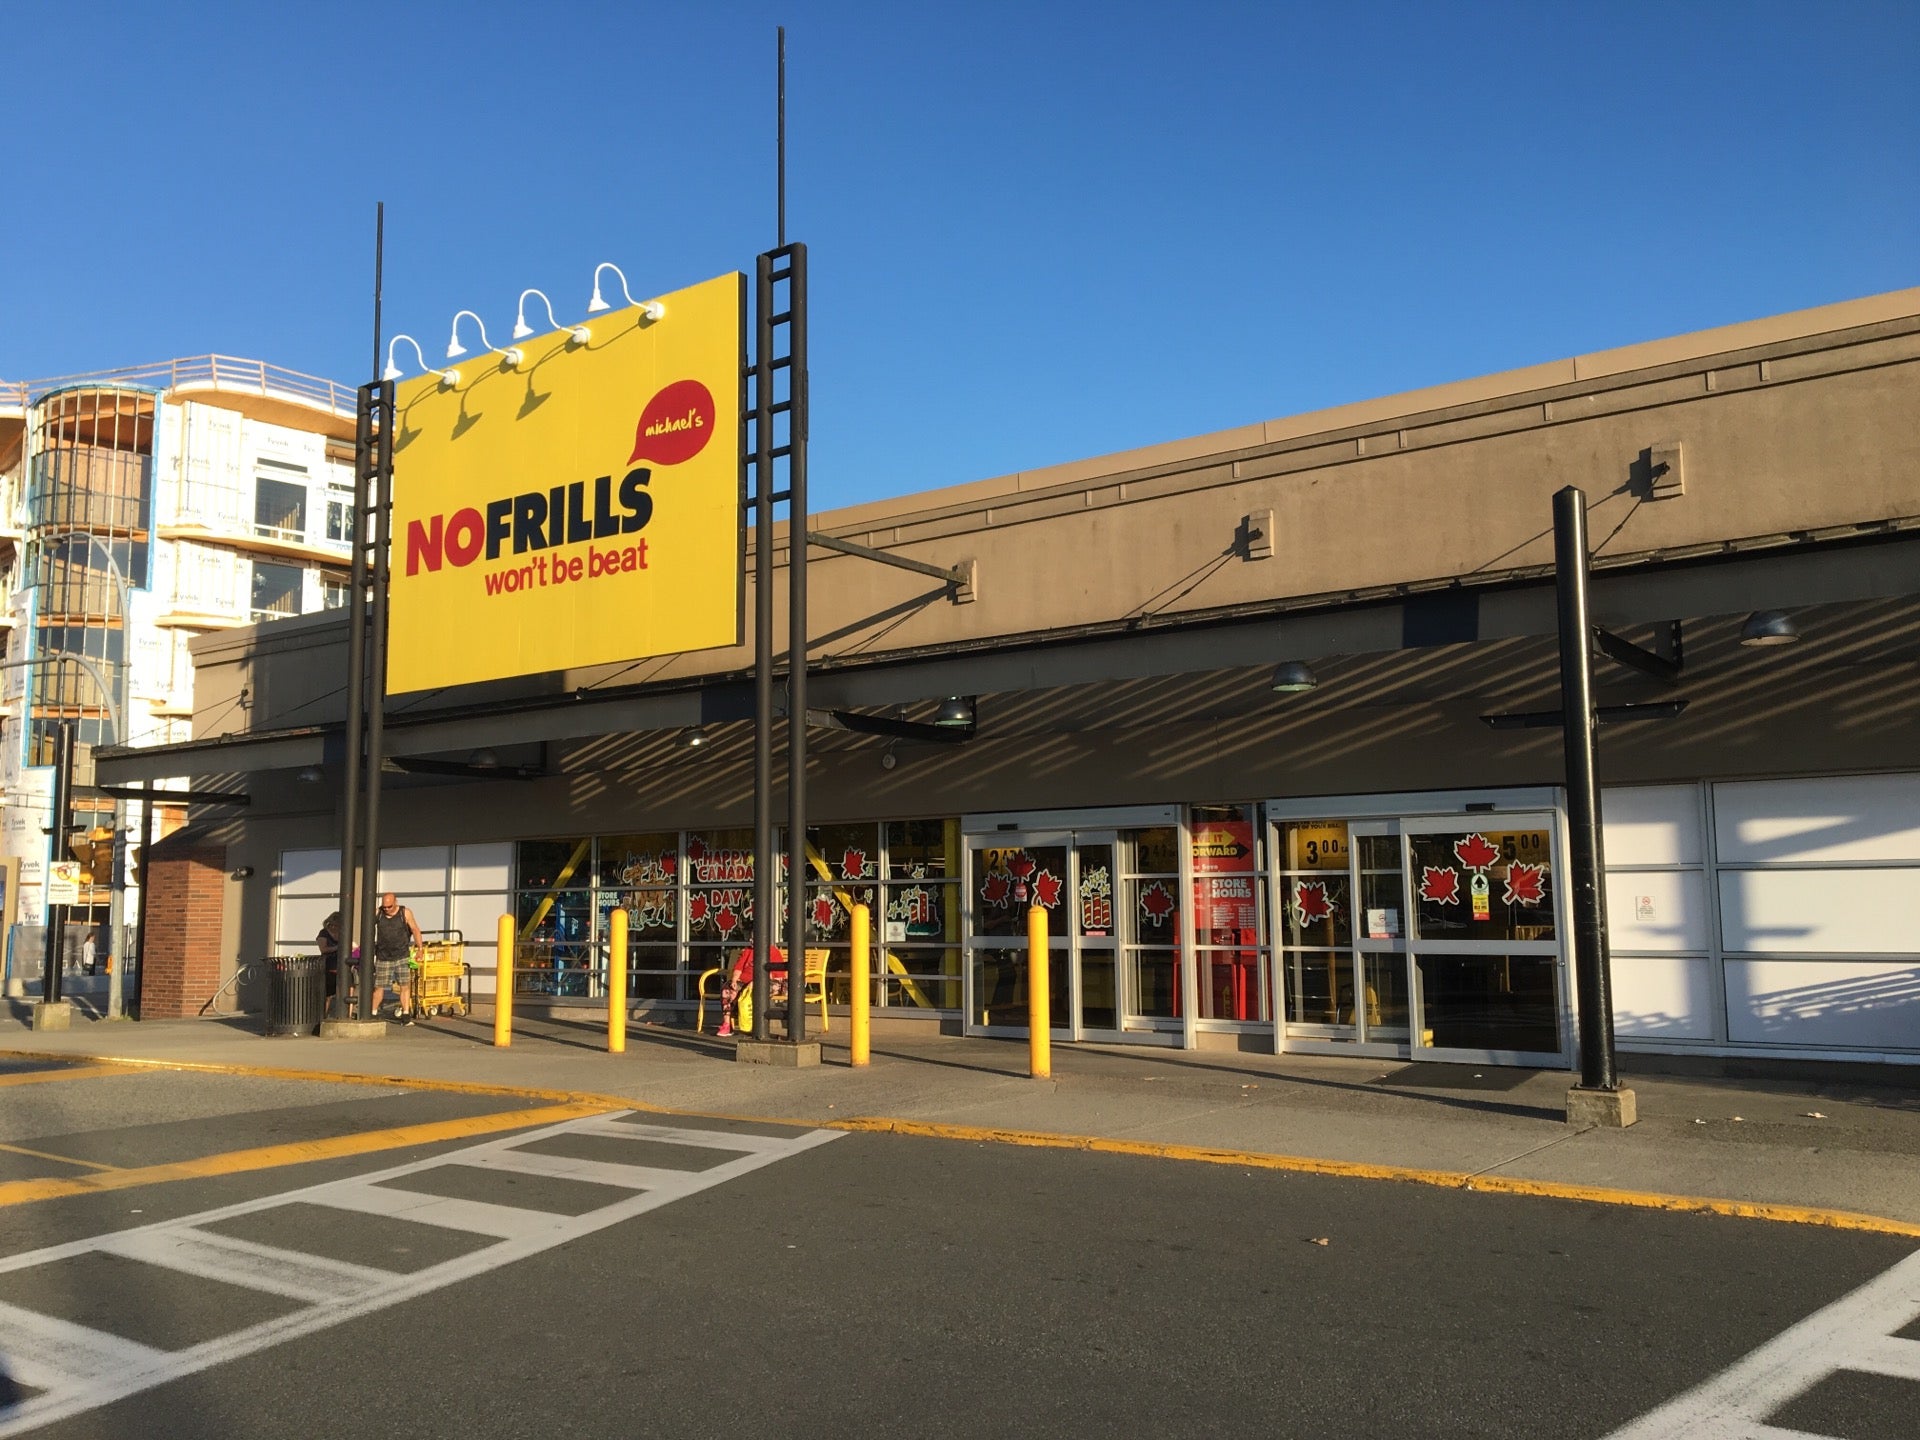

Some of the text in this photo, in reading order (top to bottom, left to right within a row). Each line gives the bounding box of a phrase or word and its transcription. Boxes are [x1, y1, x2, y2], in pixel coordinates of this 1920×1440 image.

[645, 407, 704, 437] michael's
[485, 537, 648, 597] won't be beat
[702, 849, 751, 867] HAPPY
[1192, 846, 1238, 857] ORWARD
[20, 861, 40, 870] Tyvek
[697, 863, 755, 883] CANADA
[1211, 879, 1248, 890] STORE
[1211, 888, 1252, 898] HOURS
[710, 889, 743, 907] DAY
